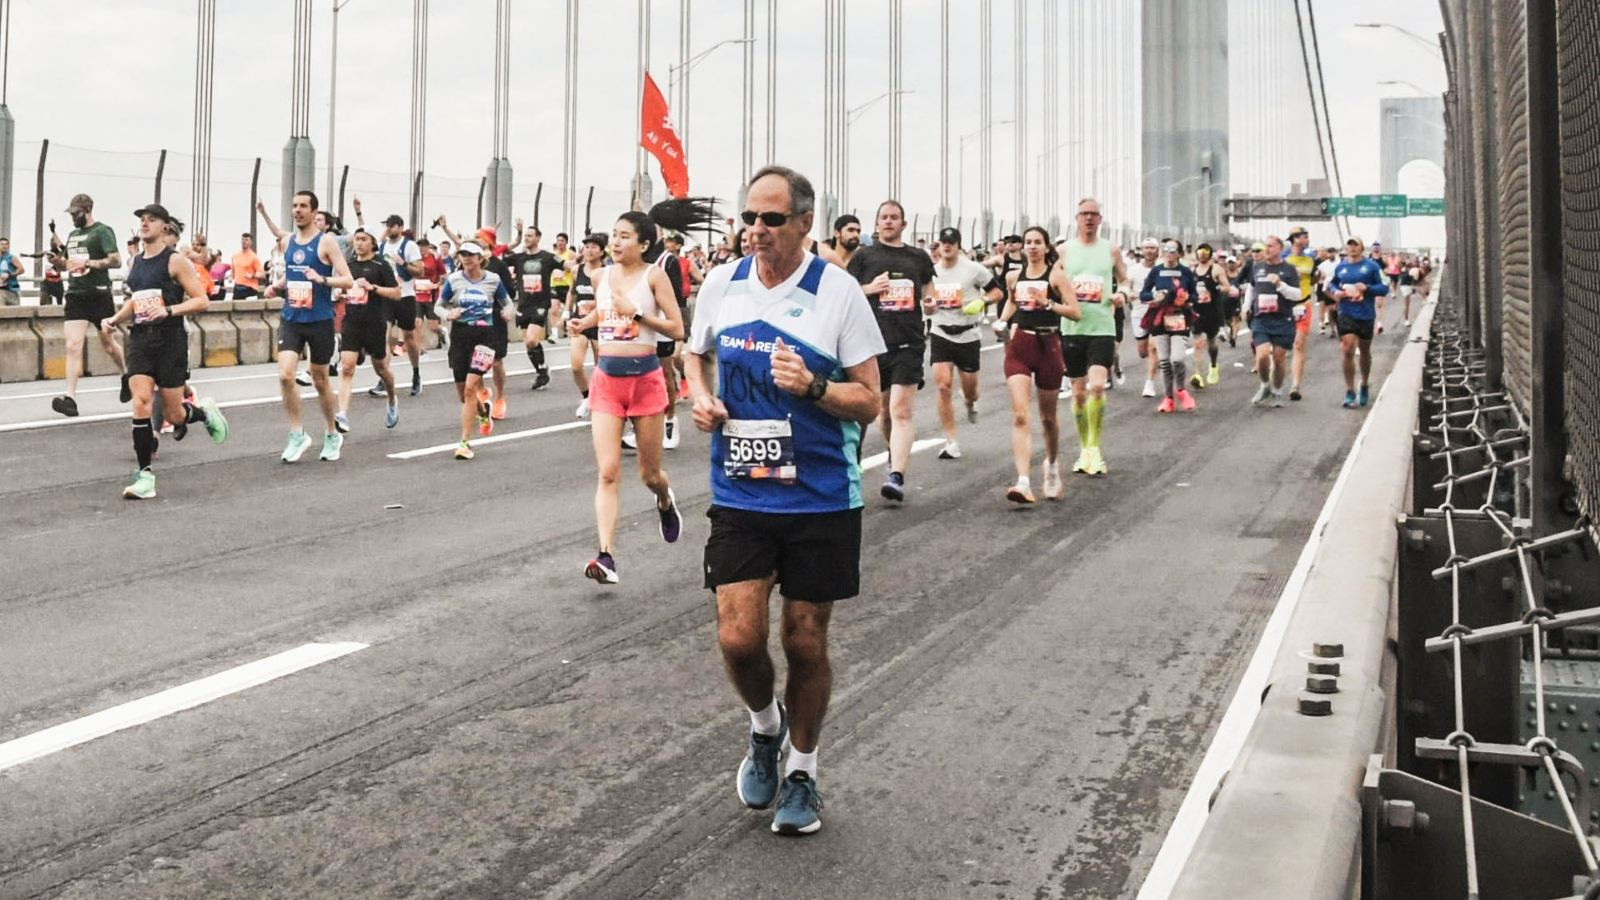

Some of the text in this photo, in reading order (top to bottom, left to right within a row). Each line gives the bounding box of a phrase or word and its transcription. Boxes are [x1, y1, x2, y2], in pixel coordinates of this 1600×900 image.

[720, 334, 797, 354] TEAM REEE
[720, 360, 778, 404] TON
[730, 438, 781, 461] 5699
